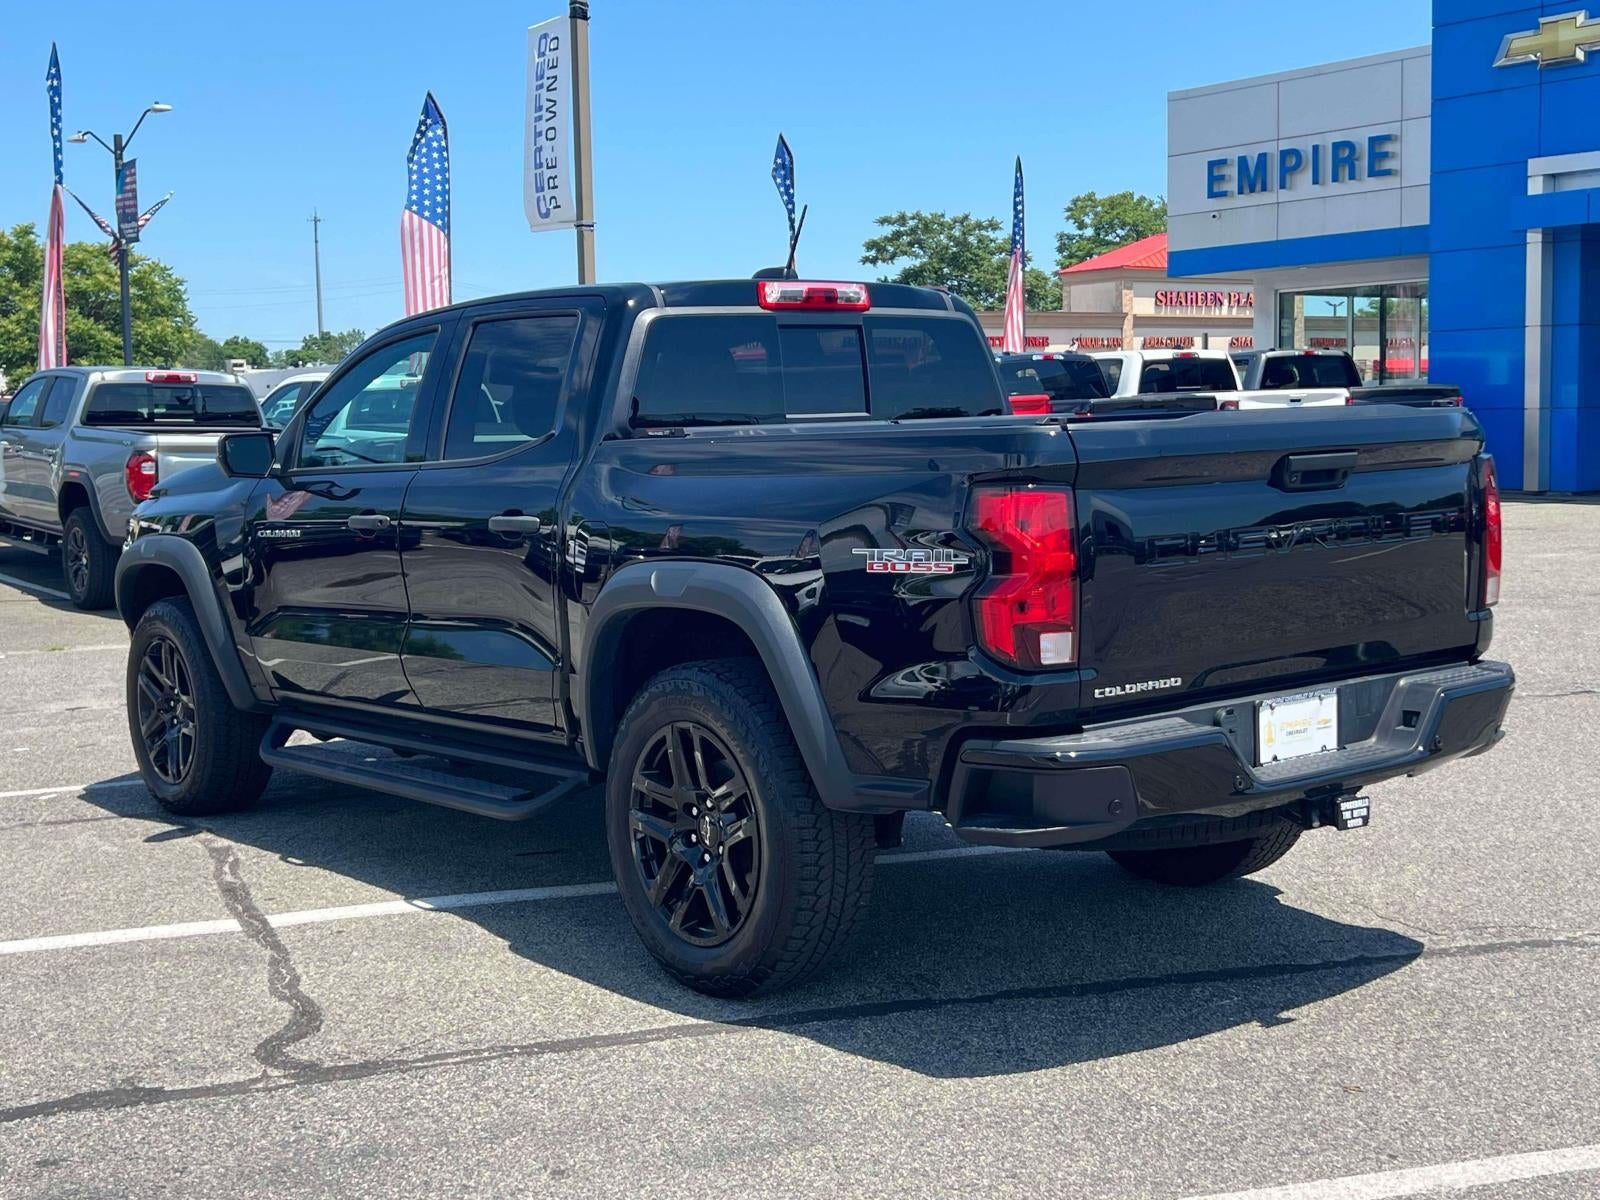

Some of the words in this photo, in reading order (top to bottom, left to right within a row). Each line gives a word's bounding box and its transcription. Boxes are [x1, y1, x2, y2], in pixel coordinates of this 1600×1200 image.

[533, 31, 551, 220] CERTIFIED
[545, 34, 562, 210] PRE-OWNED
[1206, 133, 1397, 200] EMPIRE
[1155, 289, 1224, 307] SHAHEEN
[1228, 291, 1254, 307] PLA
[851, 548, 969, 564] TRAIL
[866, 560, 954, 574] BOSS
[1093, 676, 1182, 699] COLORADO
